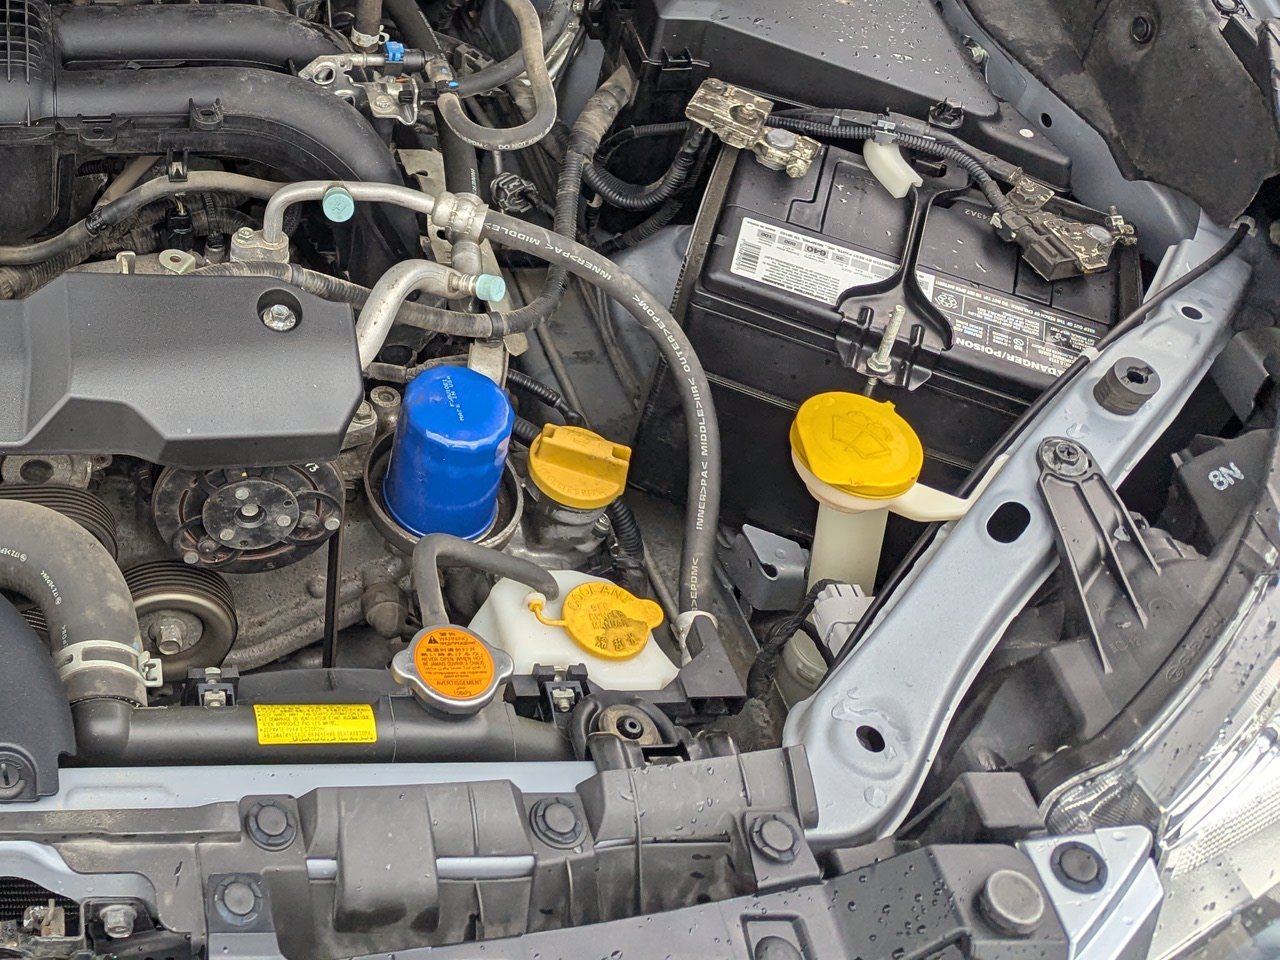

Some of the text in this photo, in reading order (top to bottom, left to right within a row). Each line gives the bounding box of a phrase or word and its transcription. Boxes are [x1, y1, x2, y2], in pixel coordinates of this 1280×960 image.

[543, 242, 615, 280] INNER>PA<
[805, 244, 827, 256] 640
[630, 291, 692, 374] OUTER>EPDM<
[953, 336, 1058, 375] DANGER/POISON
[695, 460, 708, 530] INNER>PA<
[1207, 461, 1245, 491] 8N
[567, 585, 634, 611] COOLANT
